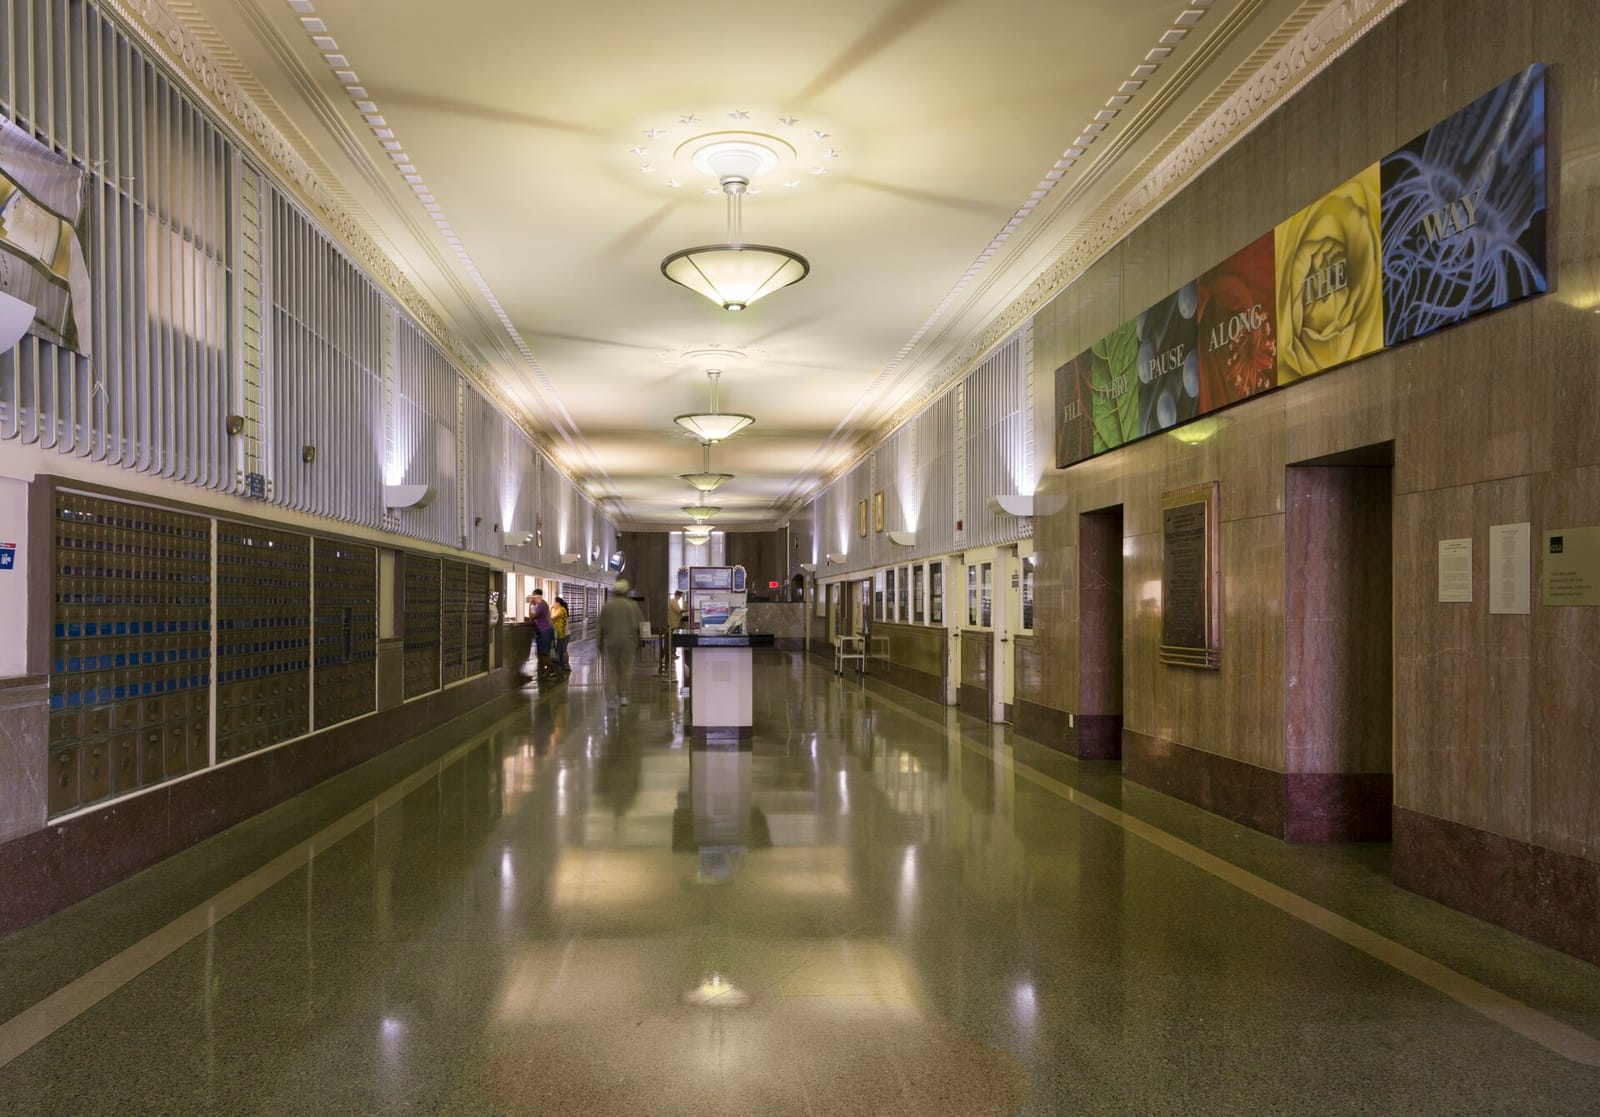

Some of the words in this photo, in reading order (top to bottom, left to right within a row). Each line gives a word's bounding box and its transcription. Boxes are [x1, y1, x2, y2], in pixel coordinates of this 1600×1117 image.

[1064, 400, 1082, 423] FILL
[1100, 374, 1129, 404] EVERY
[1149, 344, 1185, 380] PAUSE
[1208, 304, 1262, 351] ALONG
[1304, 259, 1348, 306] THE
[1422, 188, 1480, 247] WAY
